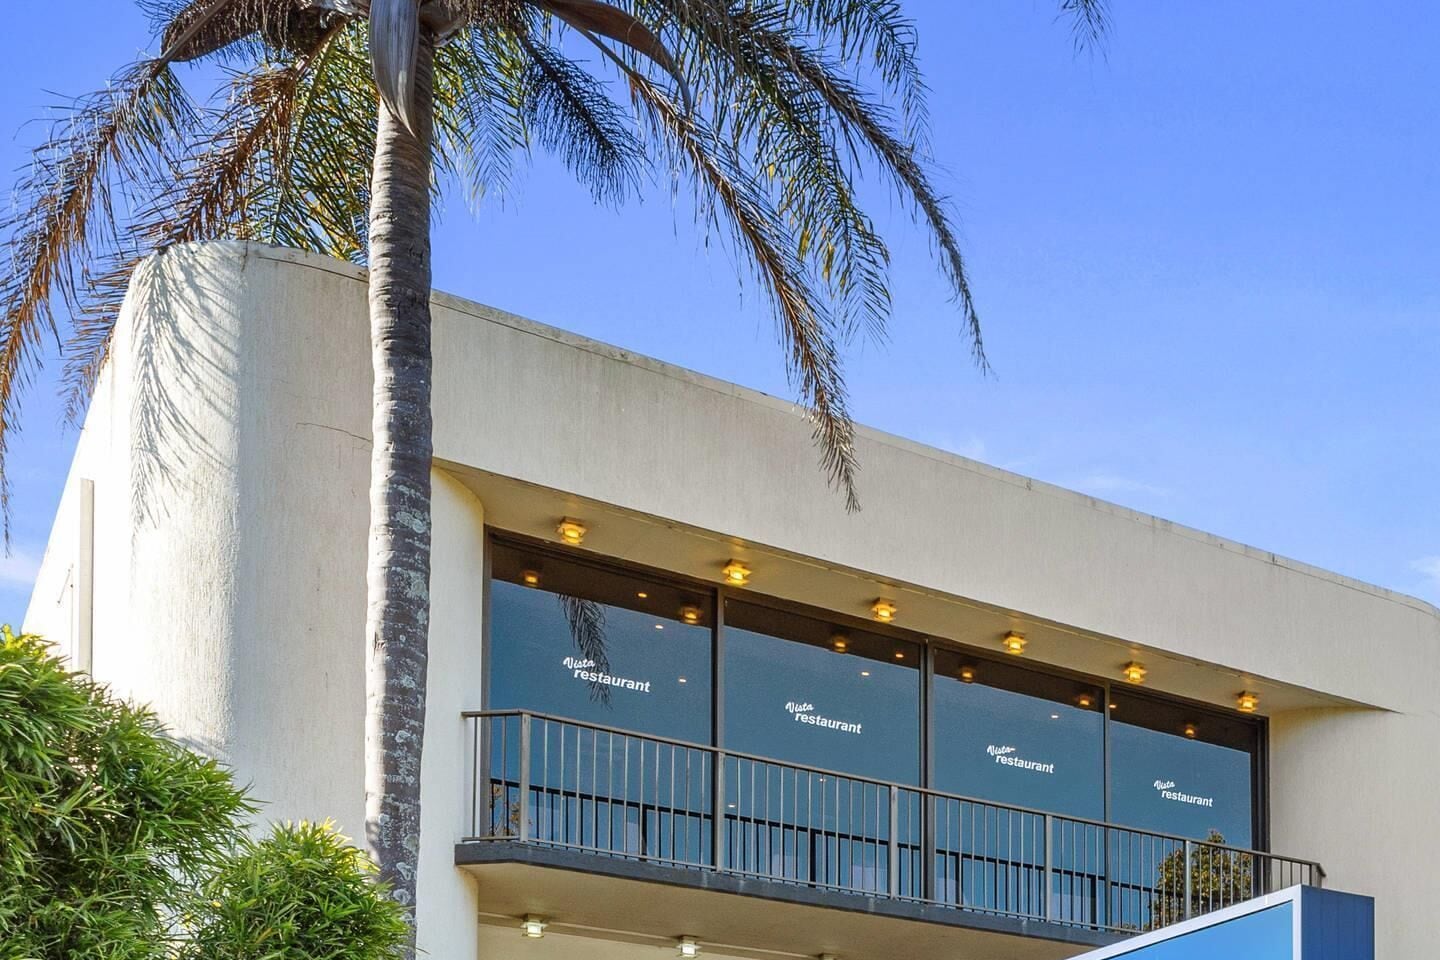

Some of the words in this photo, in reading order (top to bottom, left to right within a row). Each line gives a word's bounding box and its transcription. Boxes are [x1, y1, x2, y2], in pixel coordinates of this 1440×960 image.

[563, 657, 596, 669] Vista
[573, 669, 651, 693] restaurant
[785, 701, 814, 713] Vista
[795, 713, 862, 734] restaurant
[986, 744, 1015, 756] Vista
[995, 754, 1054, 774] restaurant
[1161, 790, 1214, 808] restaurant
